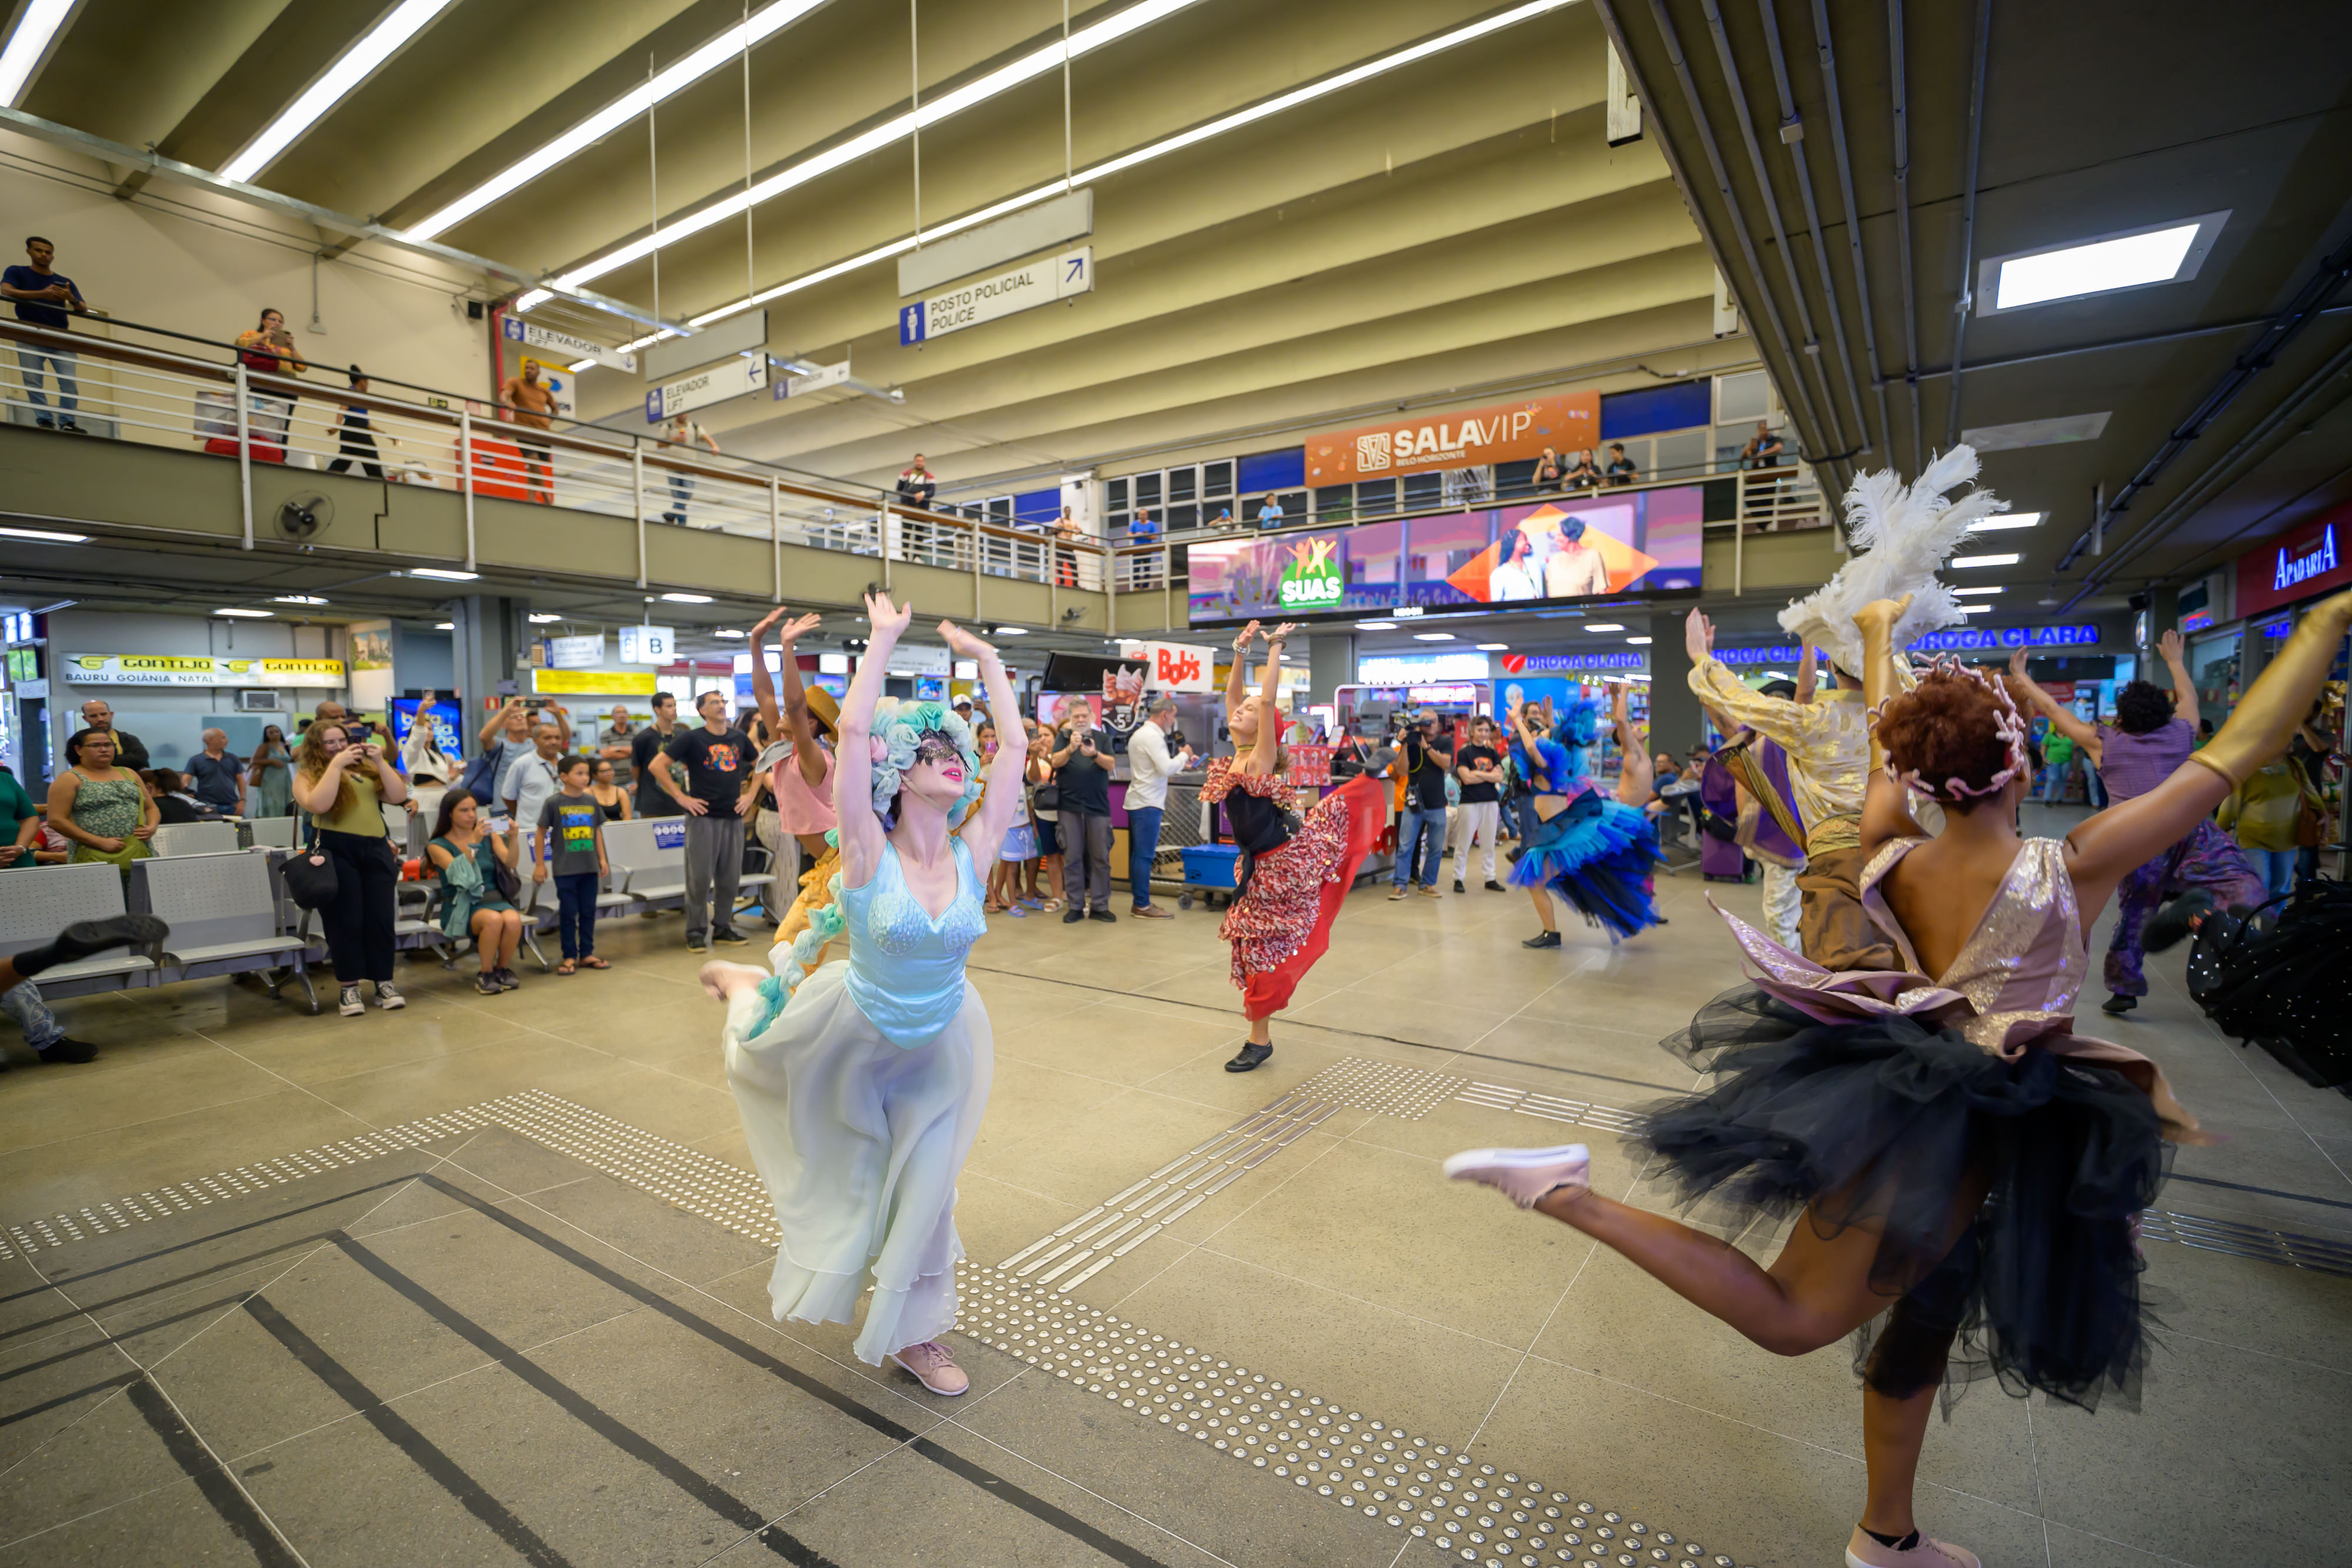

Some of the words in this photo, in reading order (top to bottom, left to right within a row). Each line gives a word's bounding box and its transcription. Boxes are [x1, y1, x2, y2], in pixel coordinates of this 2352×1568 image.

[931, 292, 971, 316] POSTO
[975, 272, 1034, 301] POLICIAL
[931, 306, 975, 332] POLICE
[529, 327, 602, 354] ELEVADOR
[666, 376, 709, 400] ELEVADOR
[666, 398, 683, 413] LIFT
[1396, 457, 1416, 467] BELO
[1417, 450, 1466, 464] HORIZONTE
[1282, 576, 1341, 603] SUAS
[2002, 625, 2097, 647] CLARA
[650, 638, 662, 653] B
[123, 658, 210, 669] GONTIJO
[1527, 654, 1583, 670] DROGA
[1585, 653, 1642, 668] CLARA
[1711, 647, 1766, 664] ROGA
[266, 663, 339, 671] GONTIJO
[1158, 648, 1200, 685] Bob's
[66, 673, 109, 681] BAURU
[117, 672, 171, 682] GOIÂNIA
[1117, 714, 1126, 728] 5
